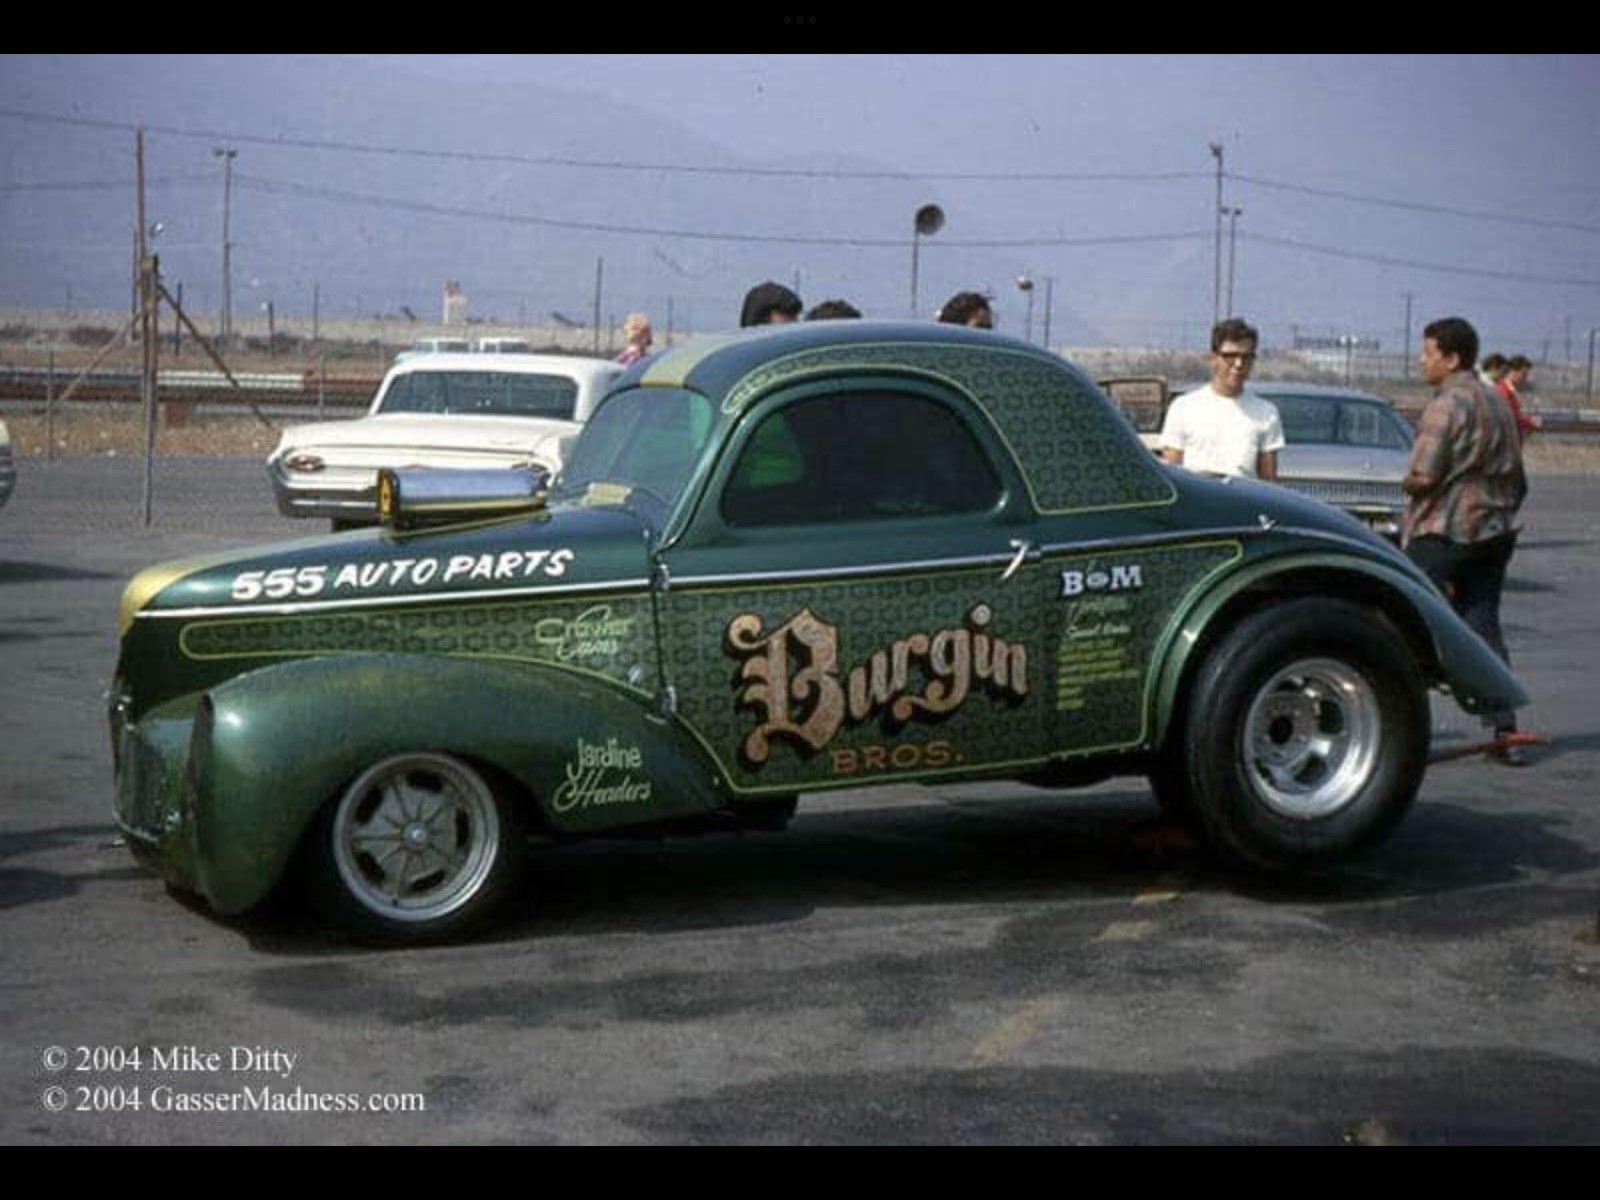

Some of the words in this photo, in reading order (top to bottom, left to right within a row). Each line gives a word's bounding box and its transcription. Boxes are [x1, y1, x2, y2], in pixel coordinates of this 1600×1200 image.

[231, 566, 325, 599] 555
[333, 559, 438, 588] AUTO
[444, 550, 575, 583] PARTS
[729, 604, 1027, 762] Burgin
[566, 737, 642, 781] Jardine
[832, 741, 964, 774] BROS.
